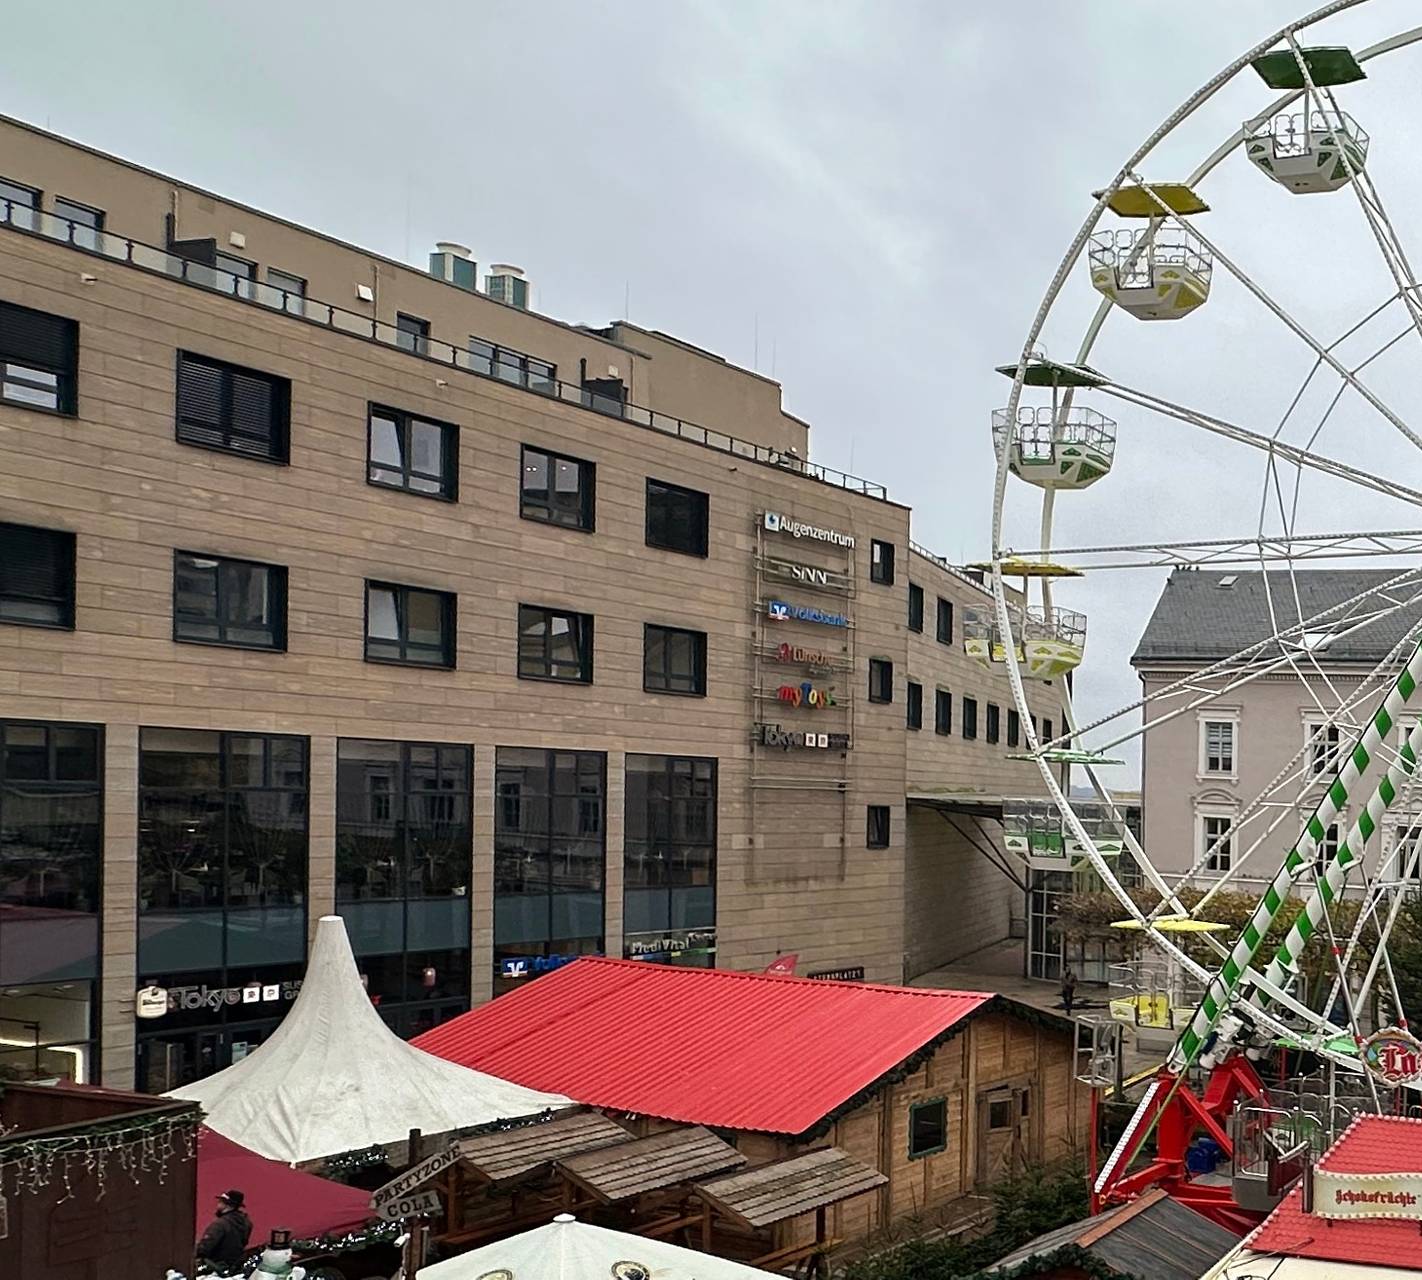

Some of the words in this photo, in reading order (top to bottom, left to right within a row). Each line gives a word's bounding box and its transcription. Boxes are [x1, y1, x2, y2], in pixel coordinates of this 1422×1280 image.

[780, 515, 855, 549] Augenzentrum
[760, 724, 803, 752] Tokyo
[168, 985, 241, 1012] Tokyo
[374, 1145, 460, 1208] PARTYZONE
[387, 1196, 434, 1217] COLA
[1336, 1189, 1416, 1207] Schokofrüchte
